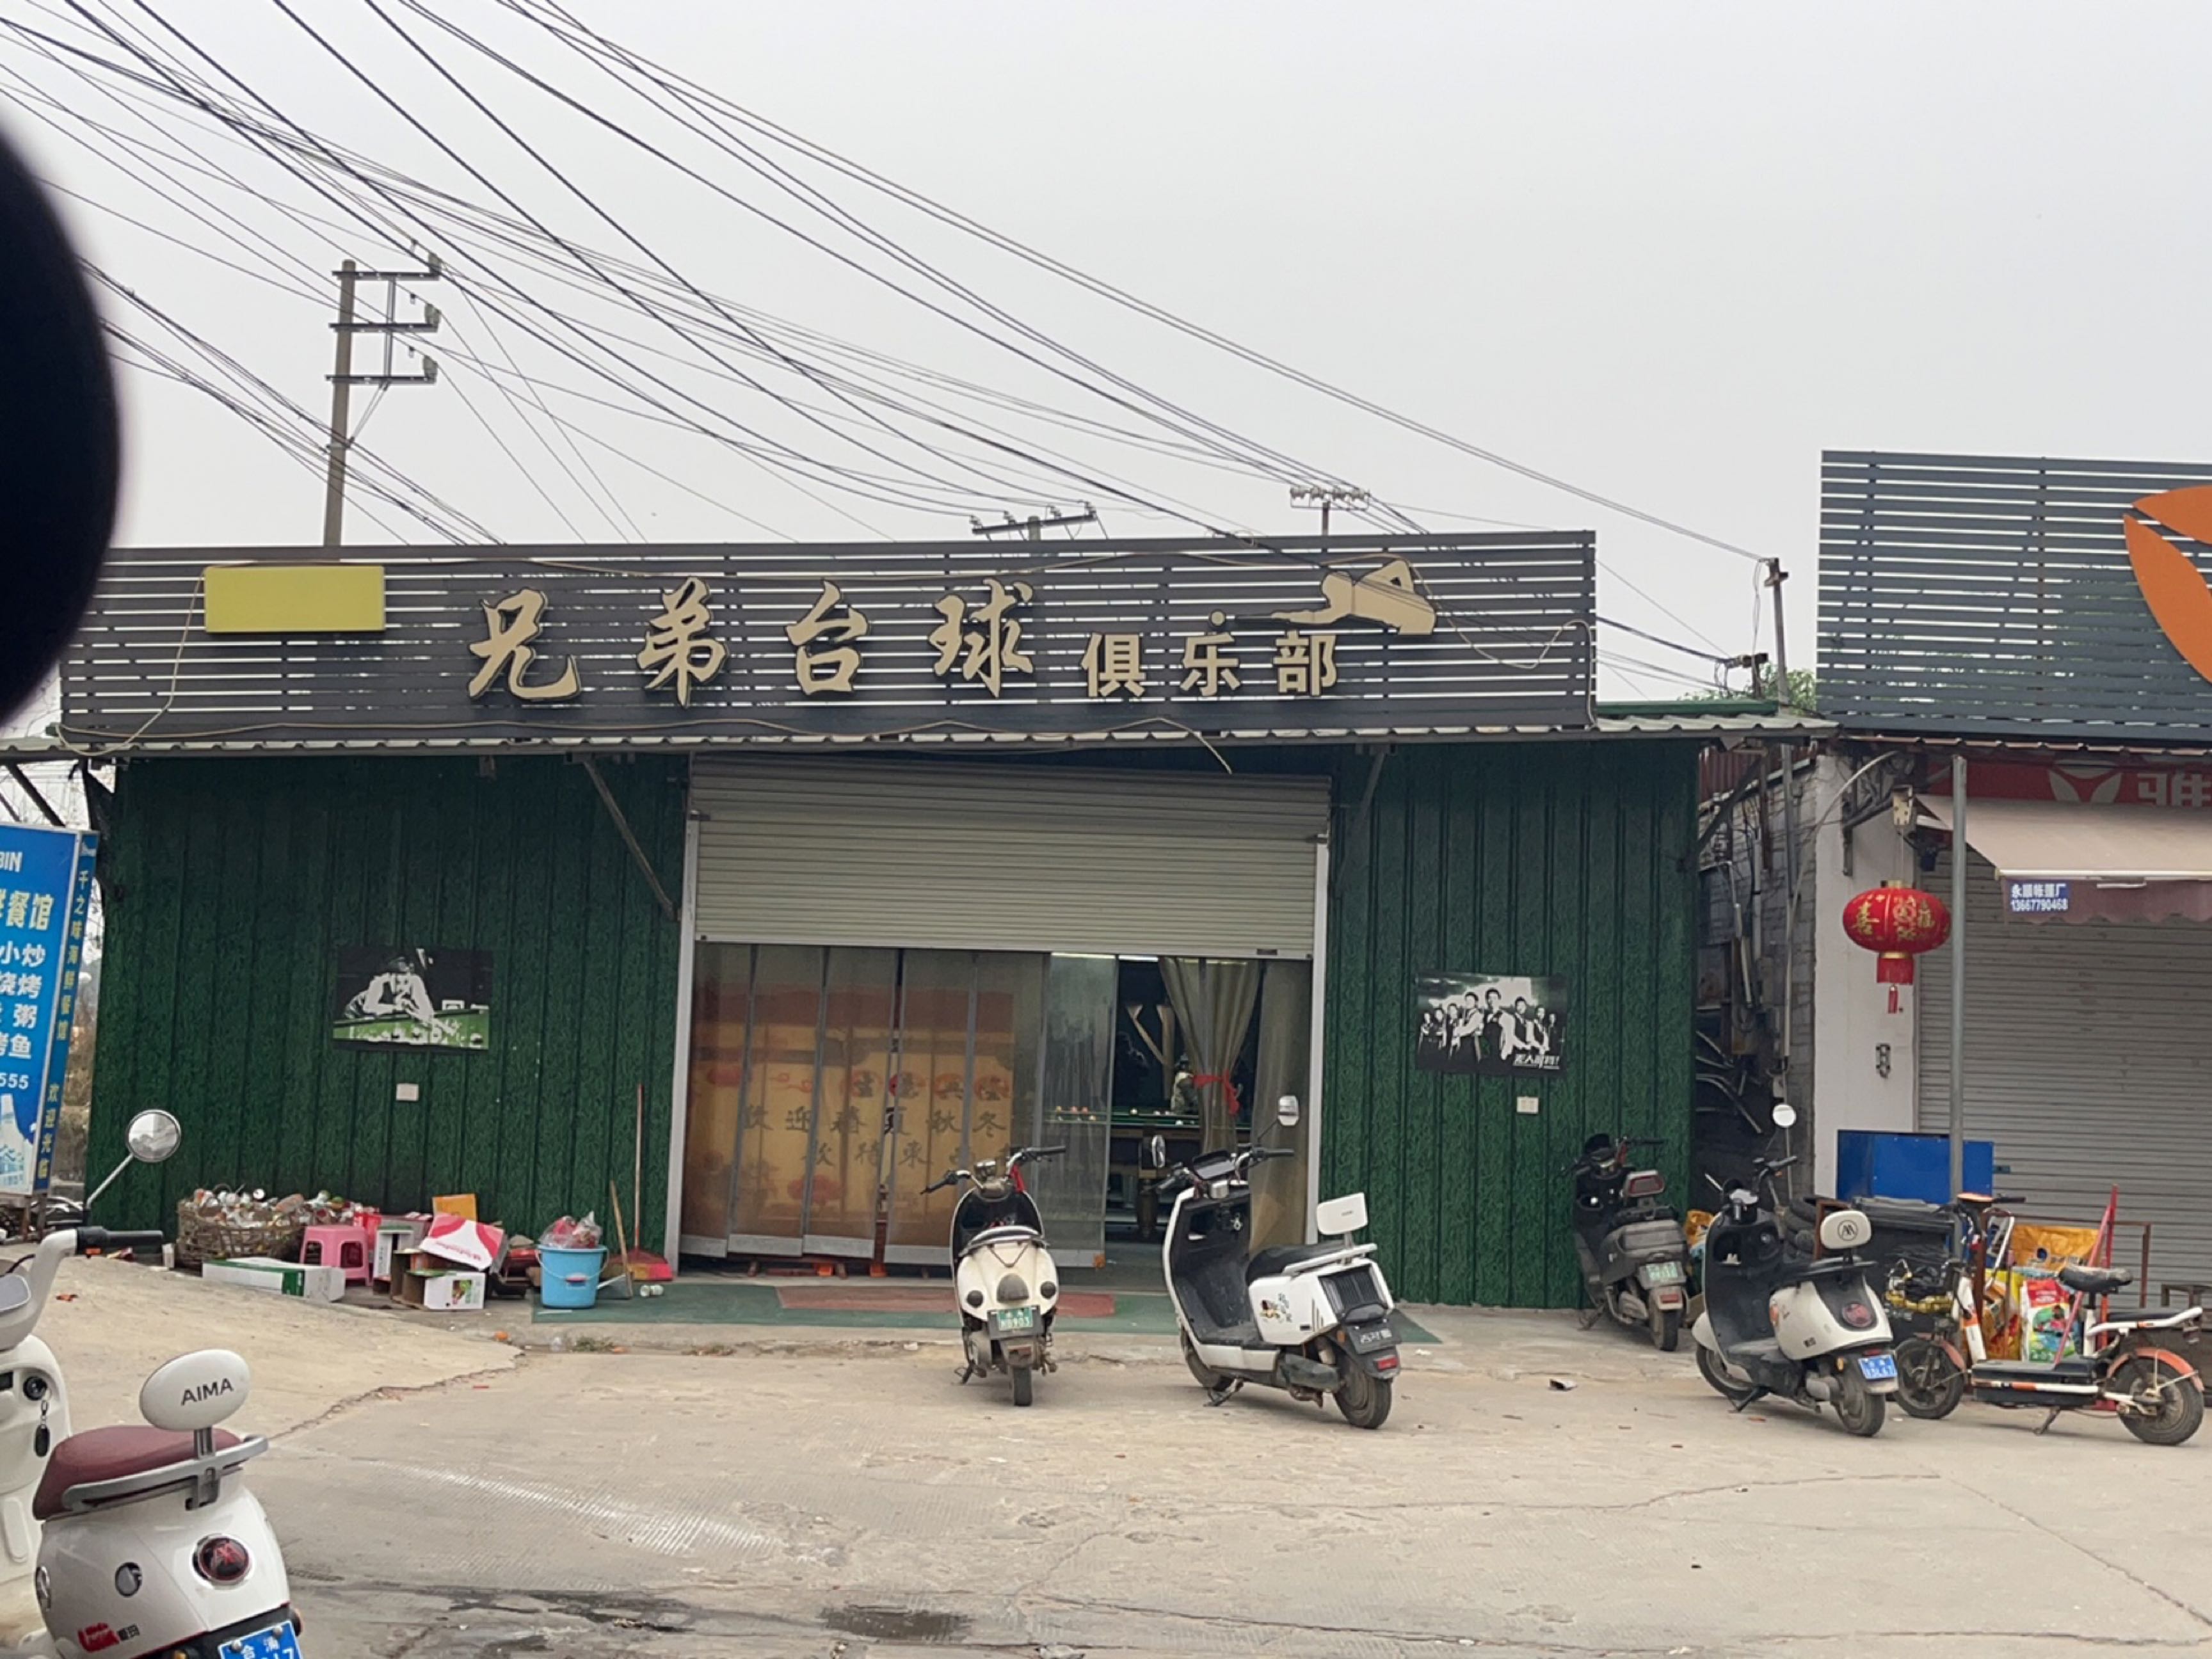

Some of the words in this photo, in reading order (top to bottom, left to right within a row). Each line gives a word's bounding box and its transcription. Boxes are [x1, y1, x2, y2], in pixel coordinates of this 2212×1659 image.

[467, 577, 1338, 707] 兄弟台球俱乐部
[180, 1377, 234, 1406] AIMA
